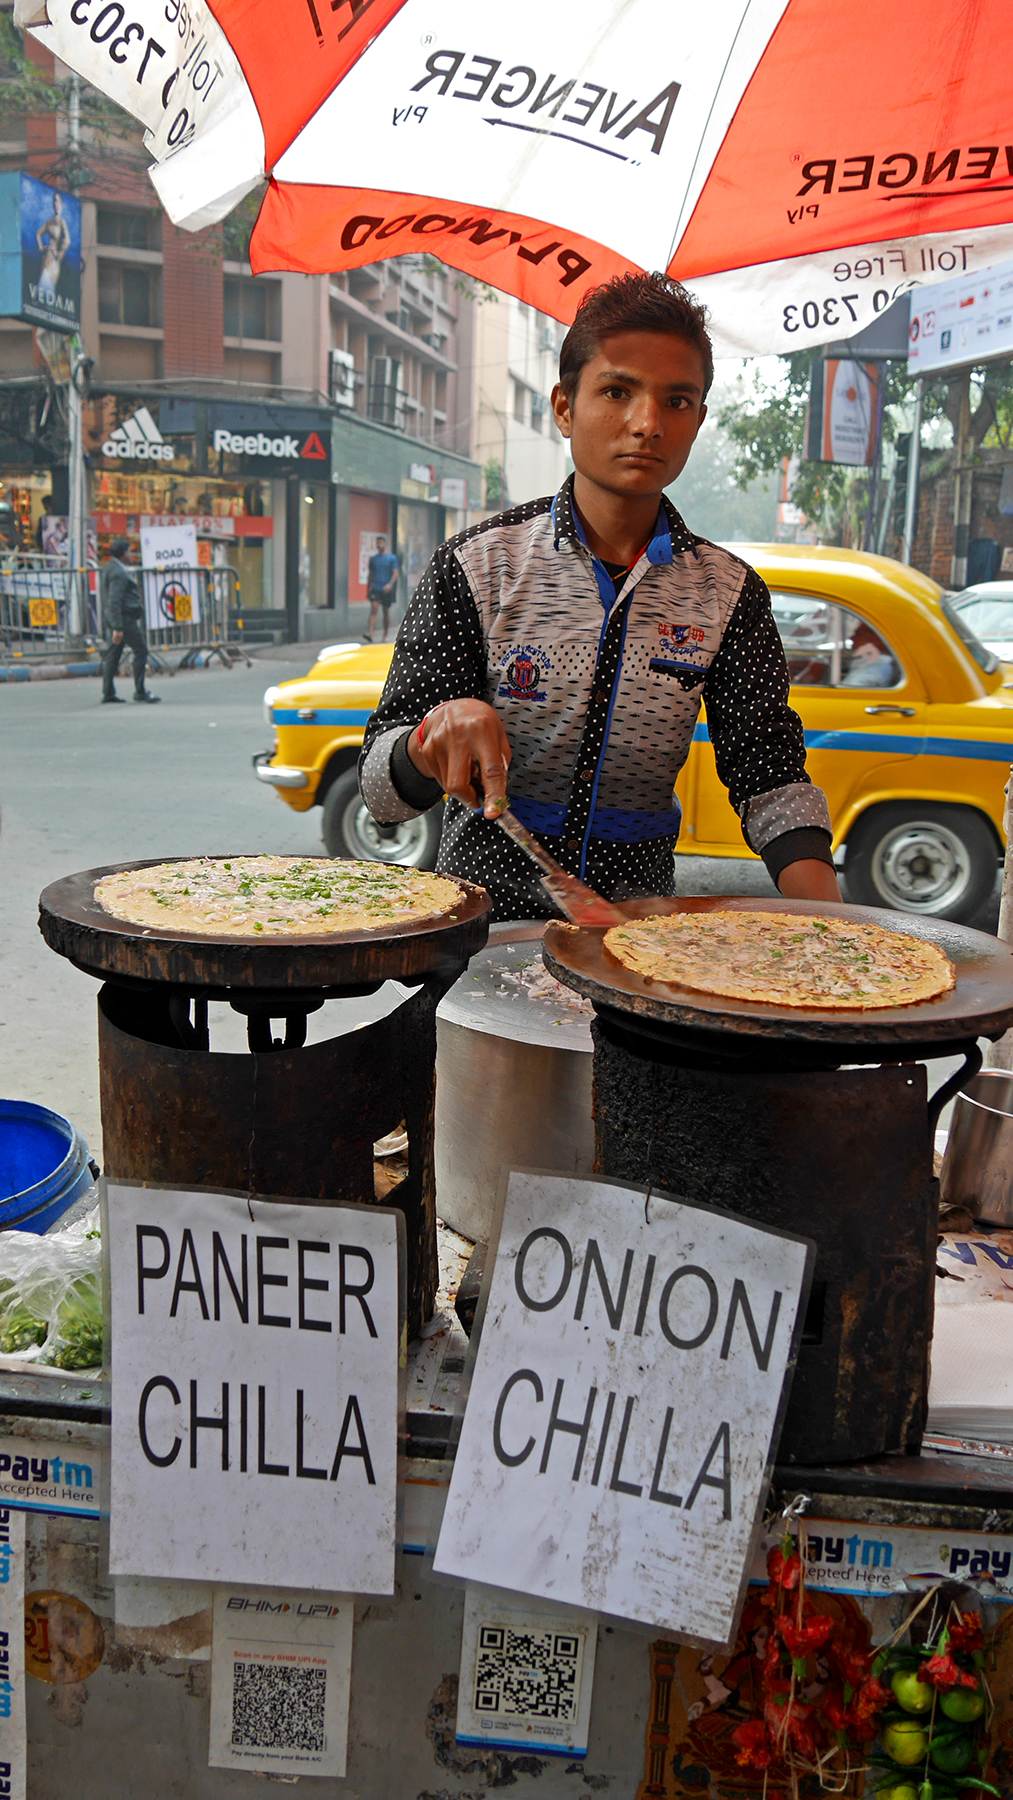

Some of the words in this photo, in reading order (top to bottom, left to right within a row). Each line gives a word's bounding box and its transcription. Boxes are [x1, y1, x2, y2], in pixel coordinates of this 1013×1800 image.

[29, 283, 76, 313] VEDAM
[101, 438, 175, 461] adidas
[214, 429, 300, 459] Reebok
[155, 548, 184, 560] ROAD
[136, 1224, 379, 1338] PANEER
[514, 1227, 783, 1372] ONION
[138, 1375, 376, 1485] CHILLA
[493, 1368, 732, 1521] CHILLA
[62, 1489, 94, 1502] Here
[789, 1534, 893, 1567] aytm
[856, 1570, 891, 1584] Here
[226, 1597, 285, 1612] BHIM
[296, 1604, 333, 1617] UPI
[312, 1657, 327, 1665] App
[243, 1751, 265, 1759] directly
